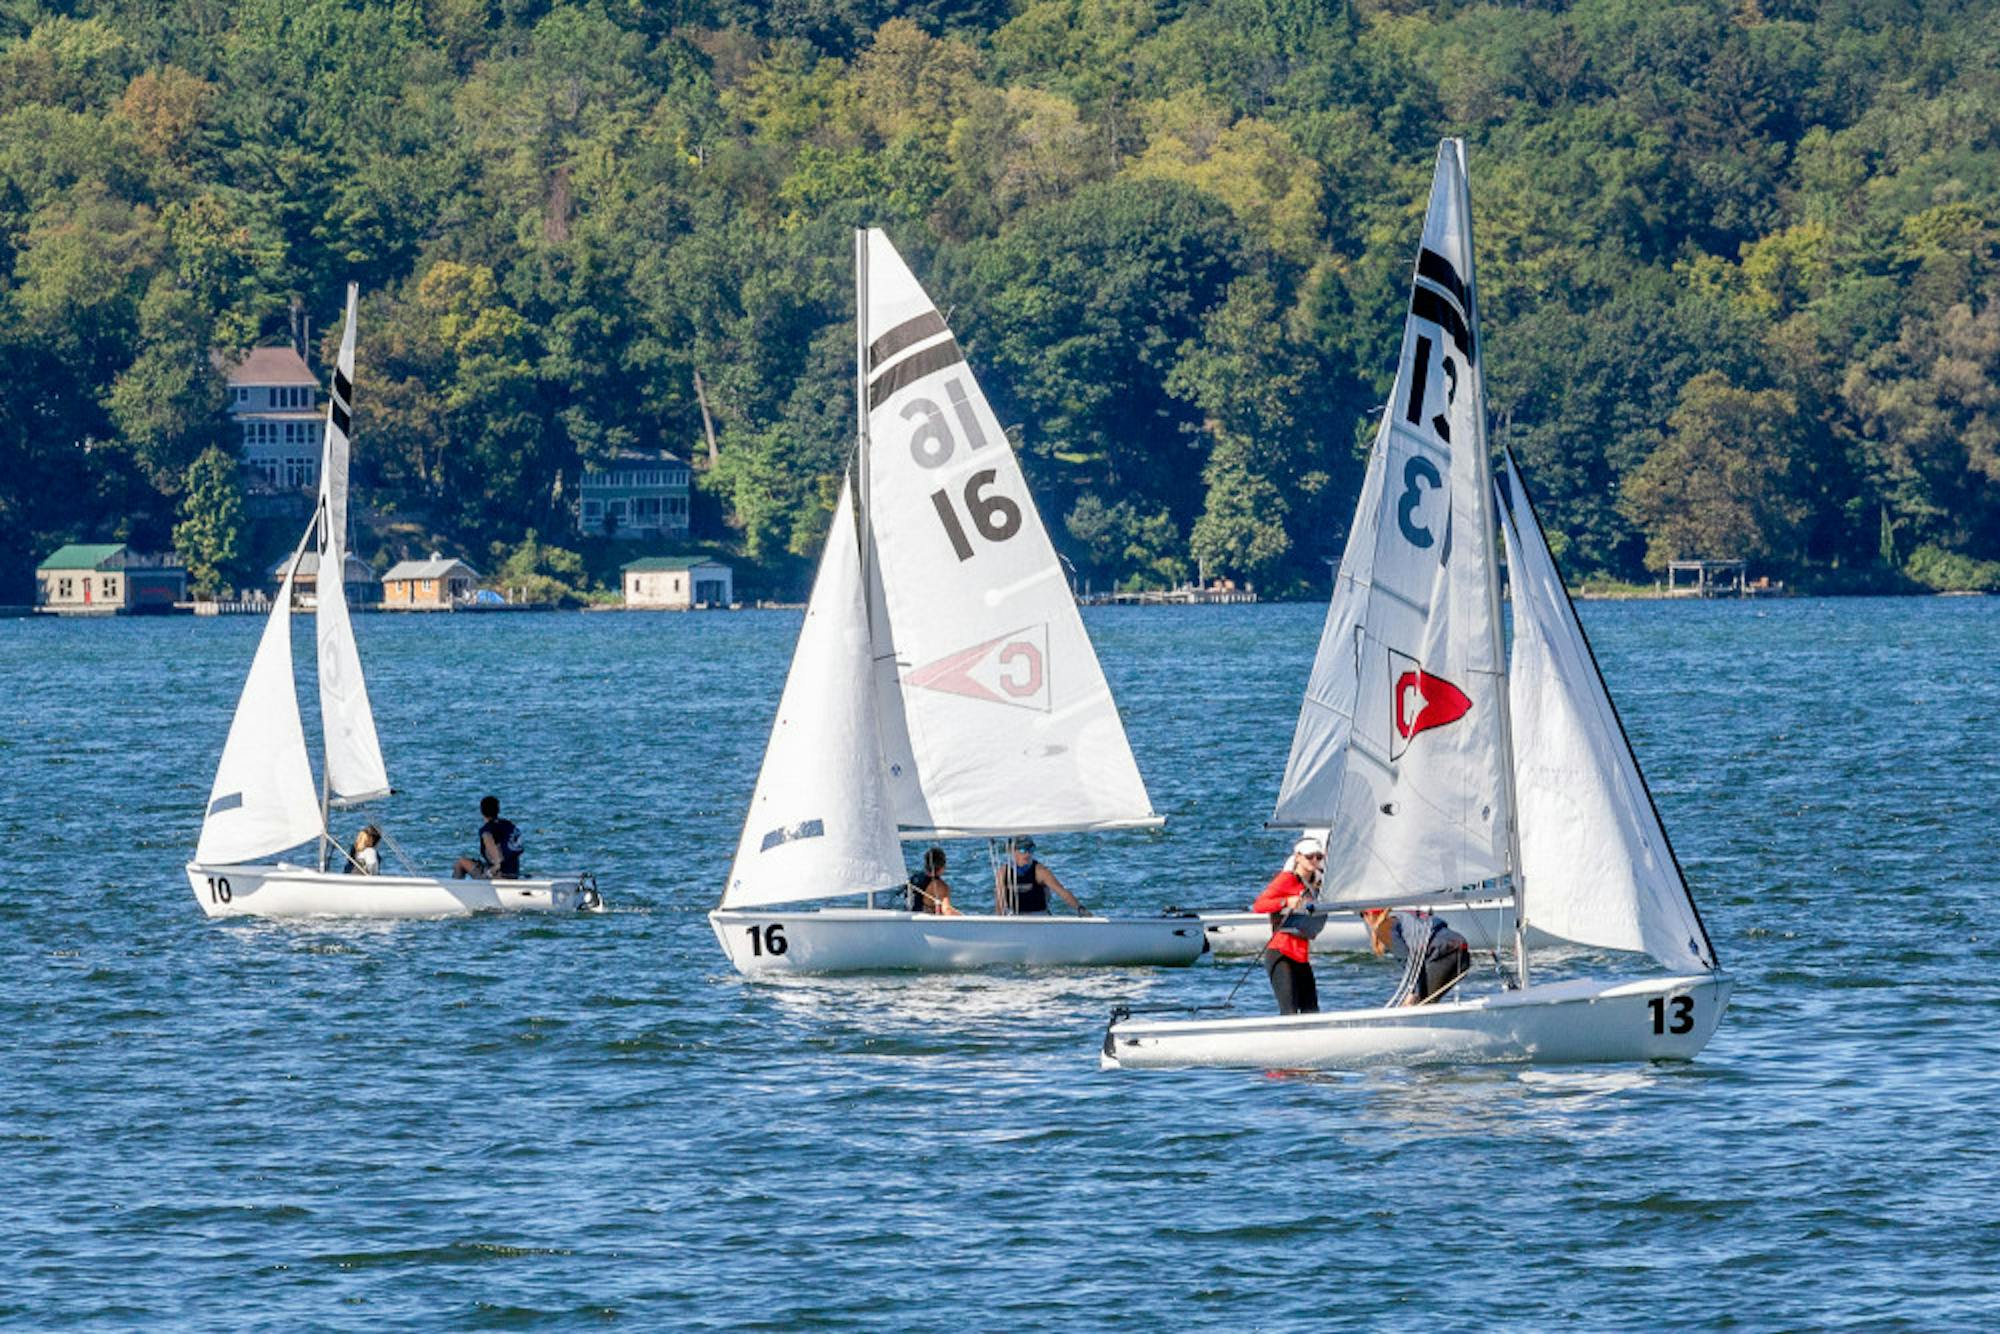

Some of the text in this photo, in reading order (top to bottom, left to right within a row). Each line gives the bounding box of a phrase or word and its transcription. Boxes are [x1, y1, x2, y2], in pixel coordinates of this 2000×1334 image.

[931, 469, 1022, 562] 16
[208, 877, 232, 904] 10
[746, 924, 788, 956] 16
[1648, 996, 1694, 1034] 13
